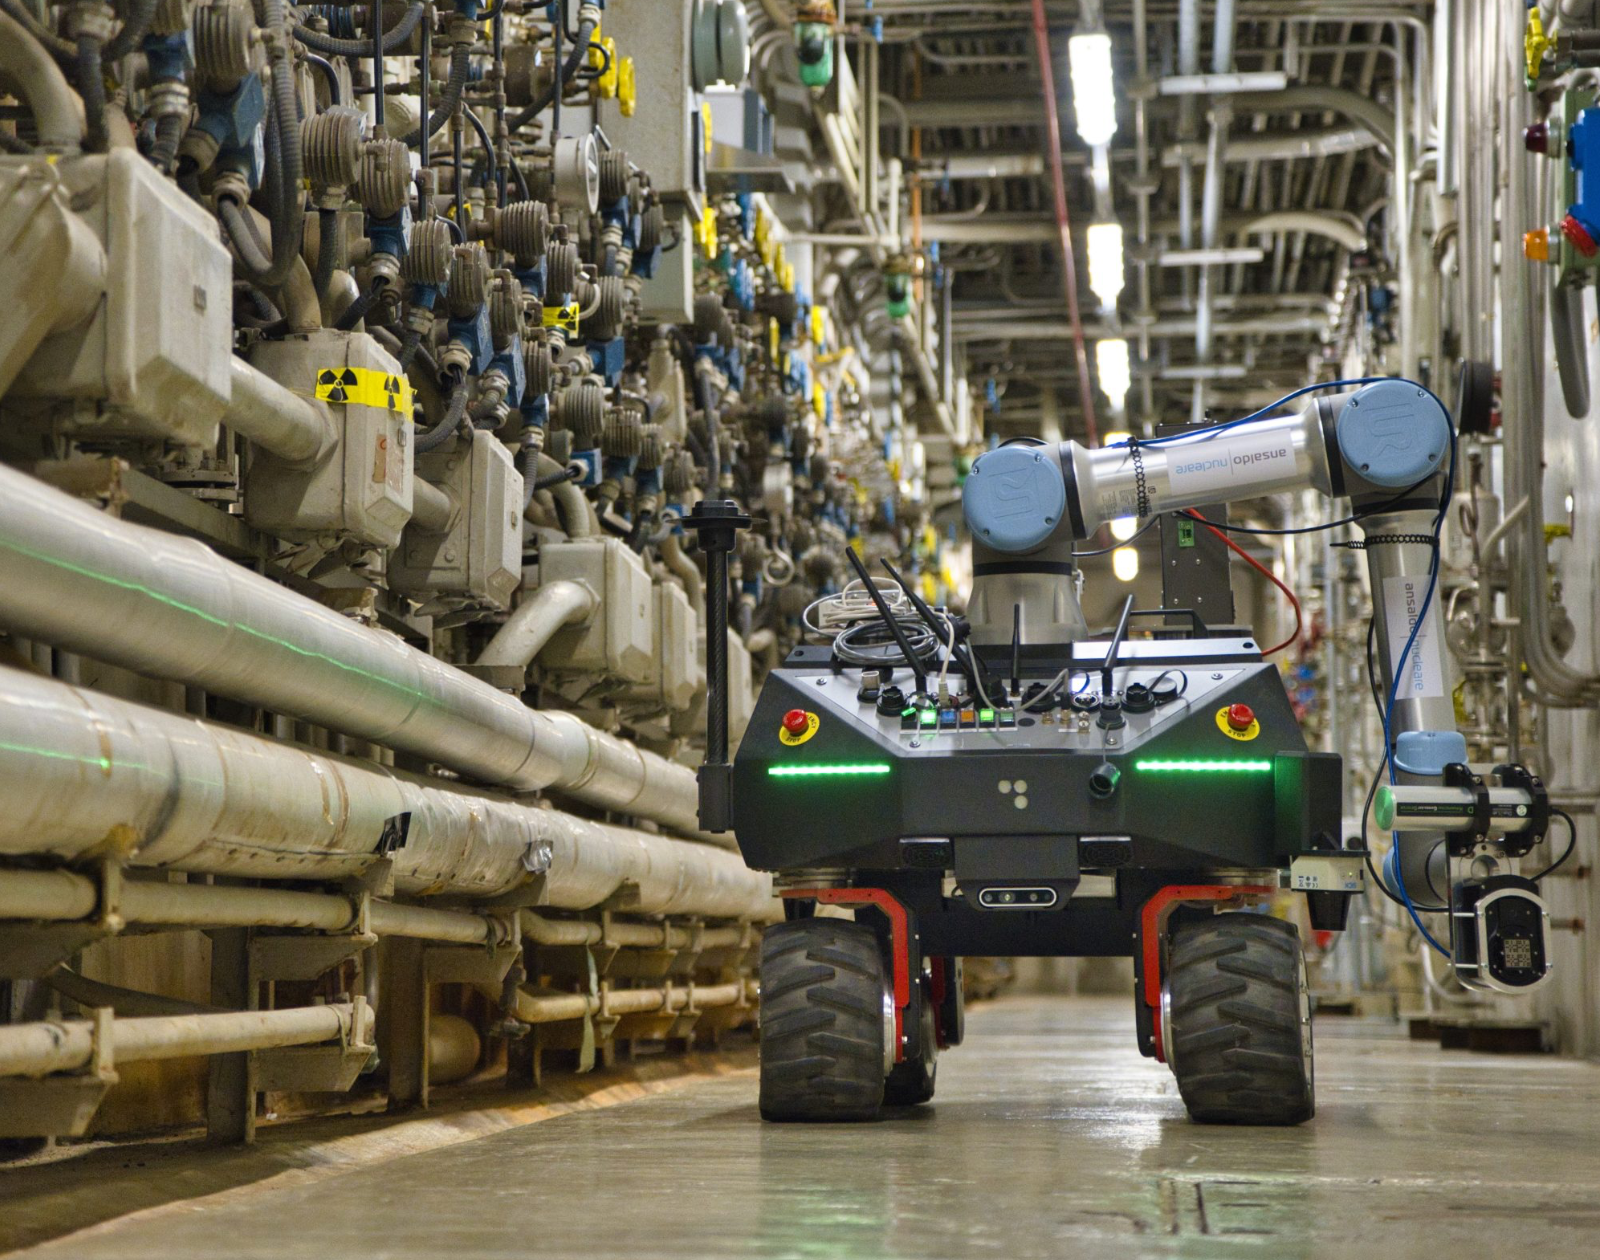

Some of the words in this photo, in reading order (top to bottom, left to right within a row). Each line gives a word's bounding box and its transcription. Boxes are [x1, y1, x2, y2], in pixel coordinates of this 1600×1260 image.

[1233, 448, 1287, 465] ansaldo
[1175, 457, 1228, 475] nucleare
[1411, 639, 1424, 690] nucleare
